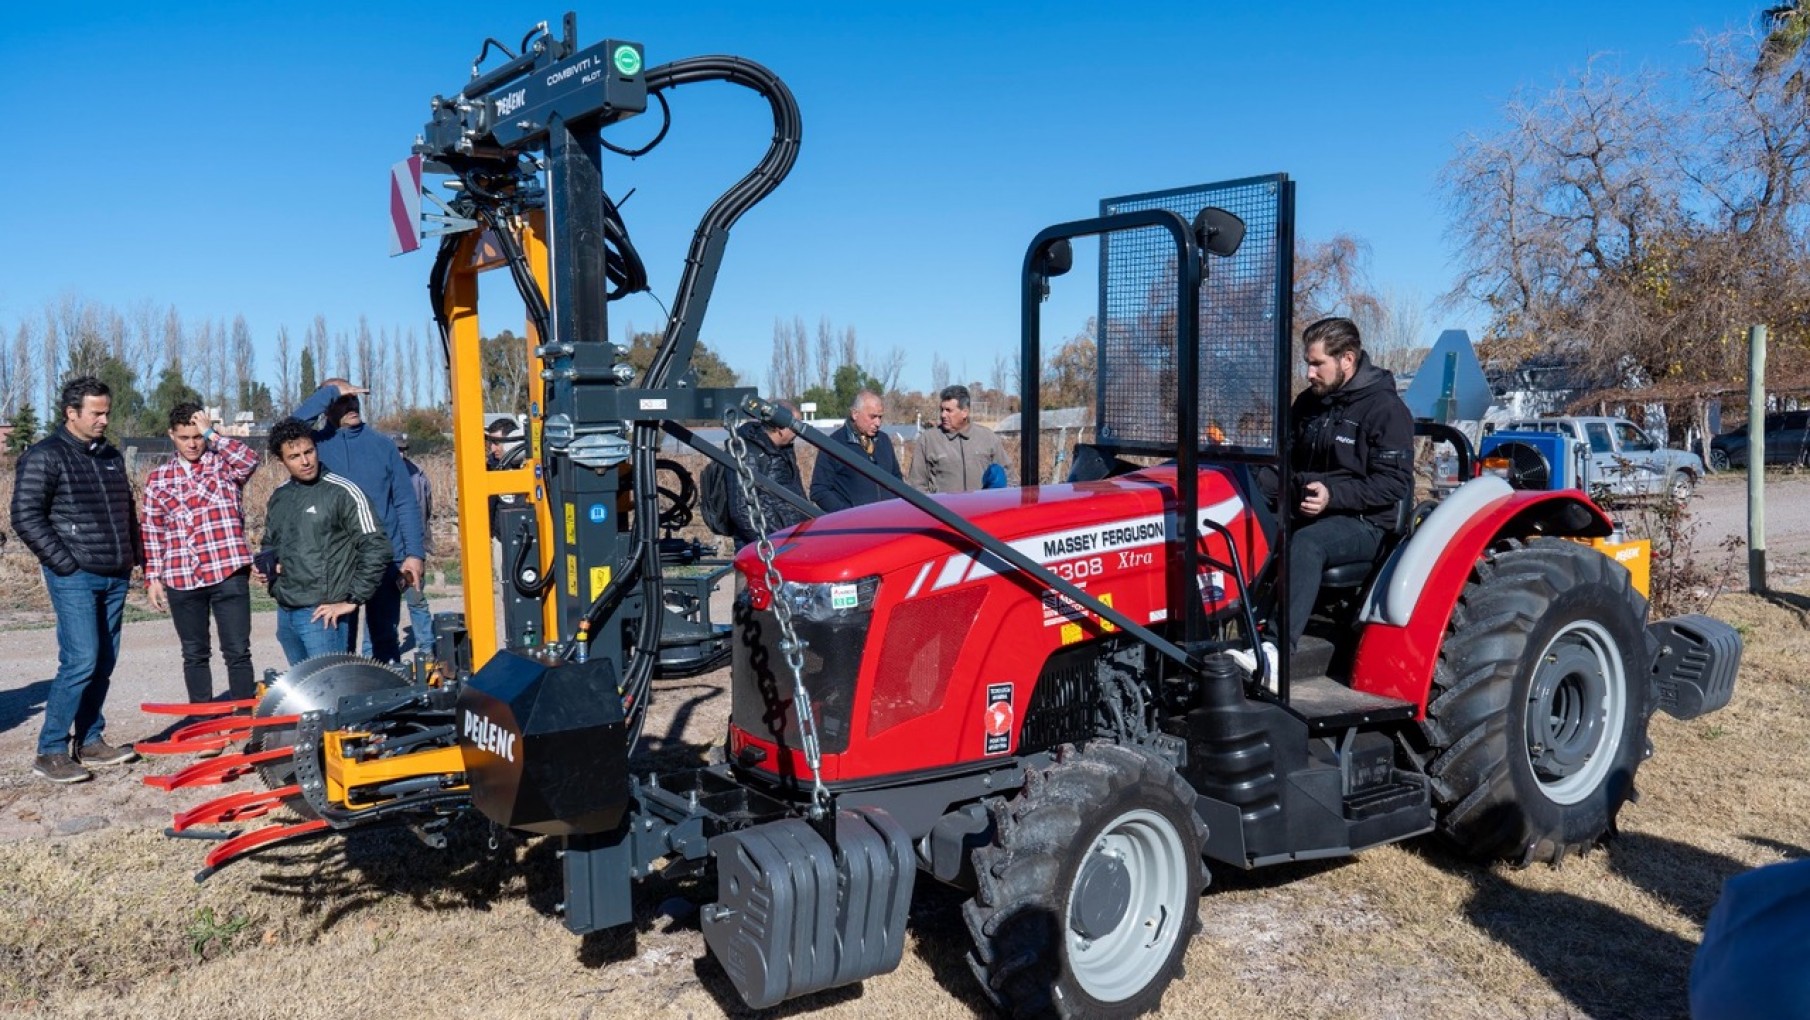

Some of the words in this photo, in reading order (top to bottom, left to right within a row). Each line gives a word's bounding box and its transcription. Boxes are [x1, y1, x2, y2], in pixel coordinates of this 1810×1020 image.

[546, 58, 591, 86] COMBIVITI
[593, 54, 601, 64] L
[582, 69, 602, 84] PILOT
[497, 88, 526, 117] PELLENC
[1043, 532, 1098, 558] MASSEY
[1101, 521, 1164, 548] FERGUSON
[1117, 551, 1153, 570] Xtra
[463, 709, 516, 763] PELLENC
